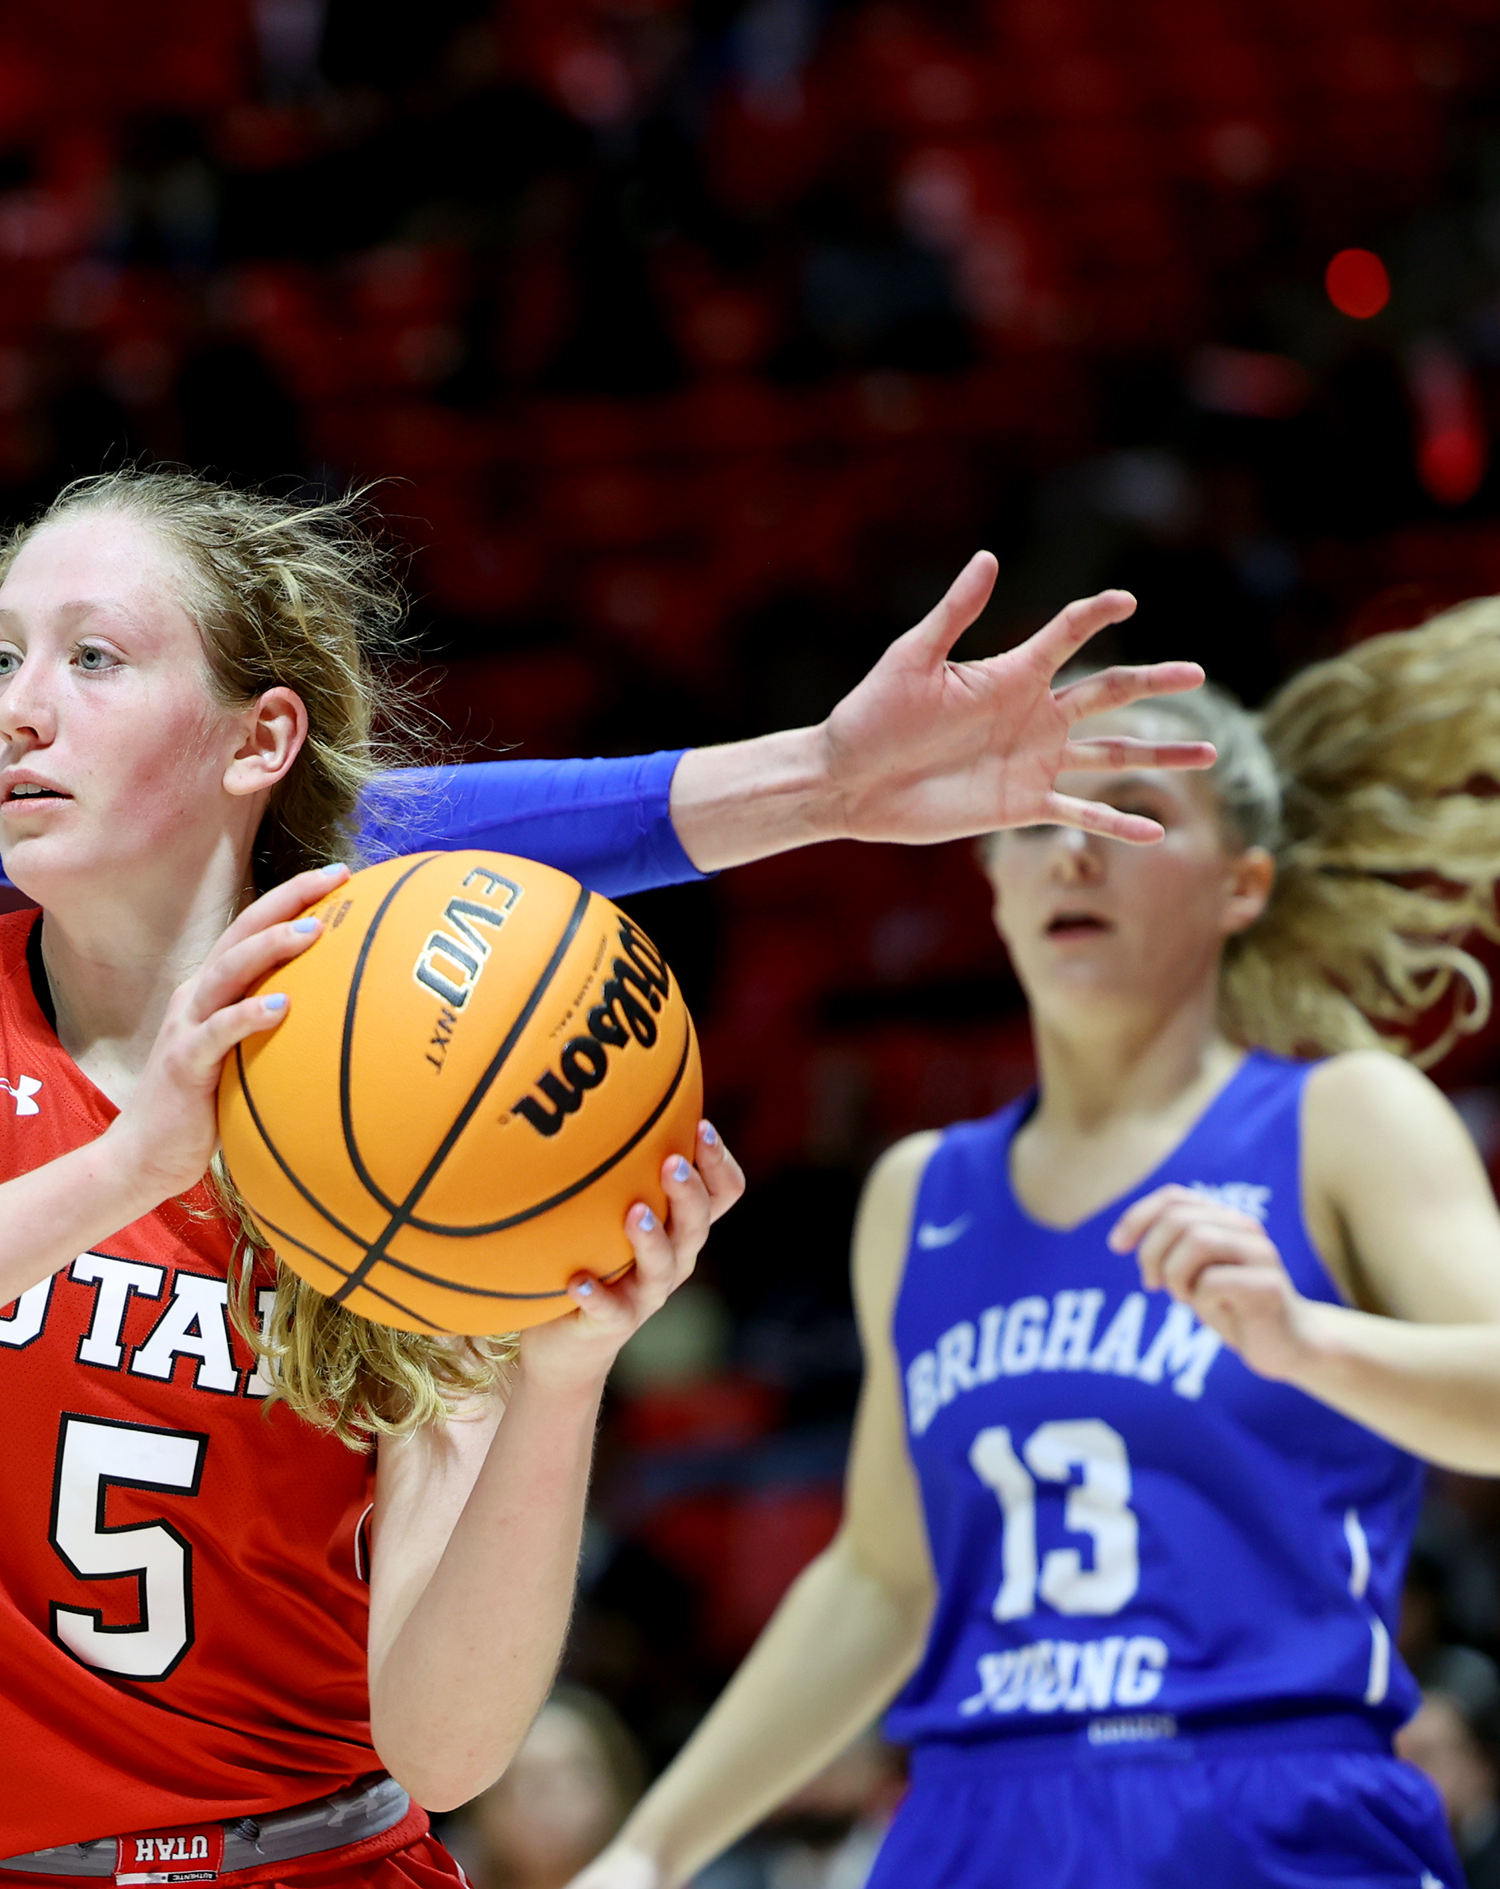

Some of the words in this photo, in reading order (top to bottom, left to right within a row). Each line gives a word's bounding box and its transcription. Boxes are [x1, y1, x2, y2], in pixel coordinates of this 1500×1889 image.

[412, 866, 524, 1012] EVO
[425, 1007, 457, 1075] NXT
[511, 915, 669, 1138] Wilson
[906, 1288, 1227, 1437] BRIGHAM
[48, 1410, 210, 1682] 5
[968, 1417, 1140, 1623] 13
[135, 1835, 208, 1862] UTAH
[172, 1872, 213, 1881] AUTHENTIC
